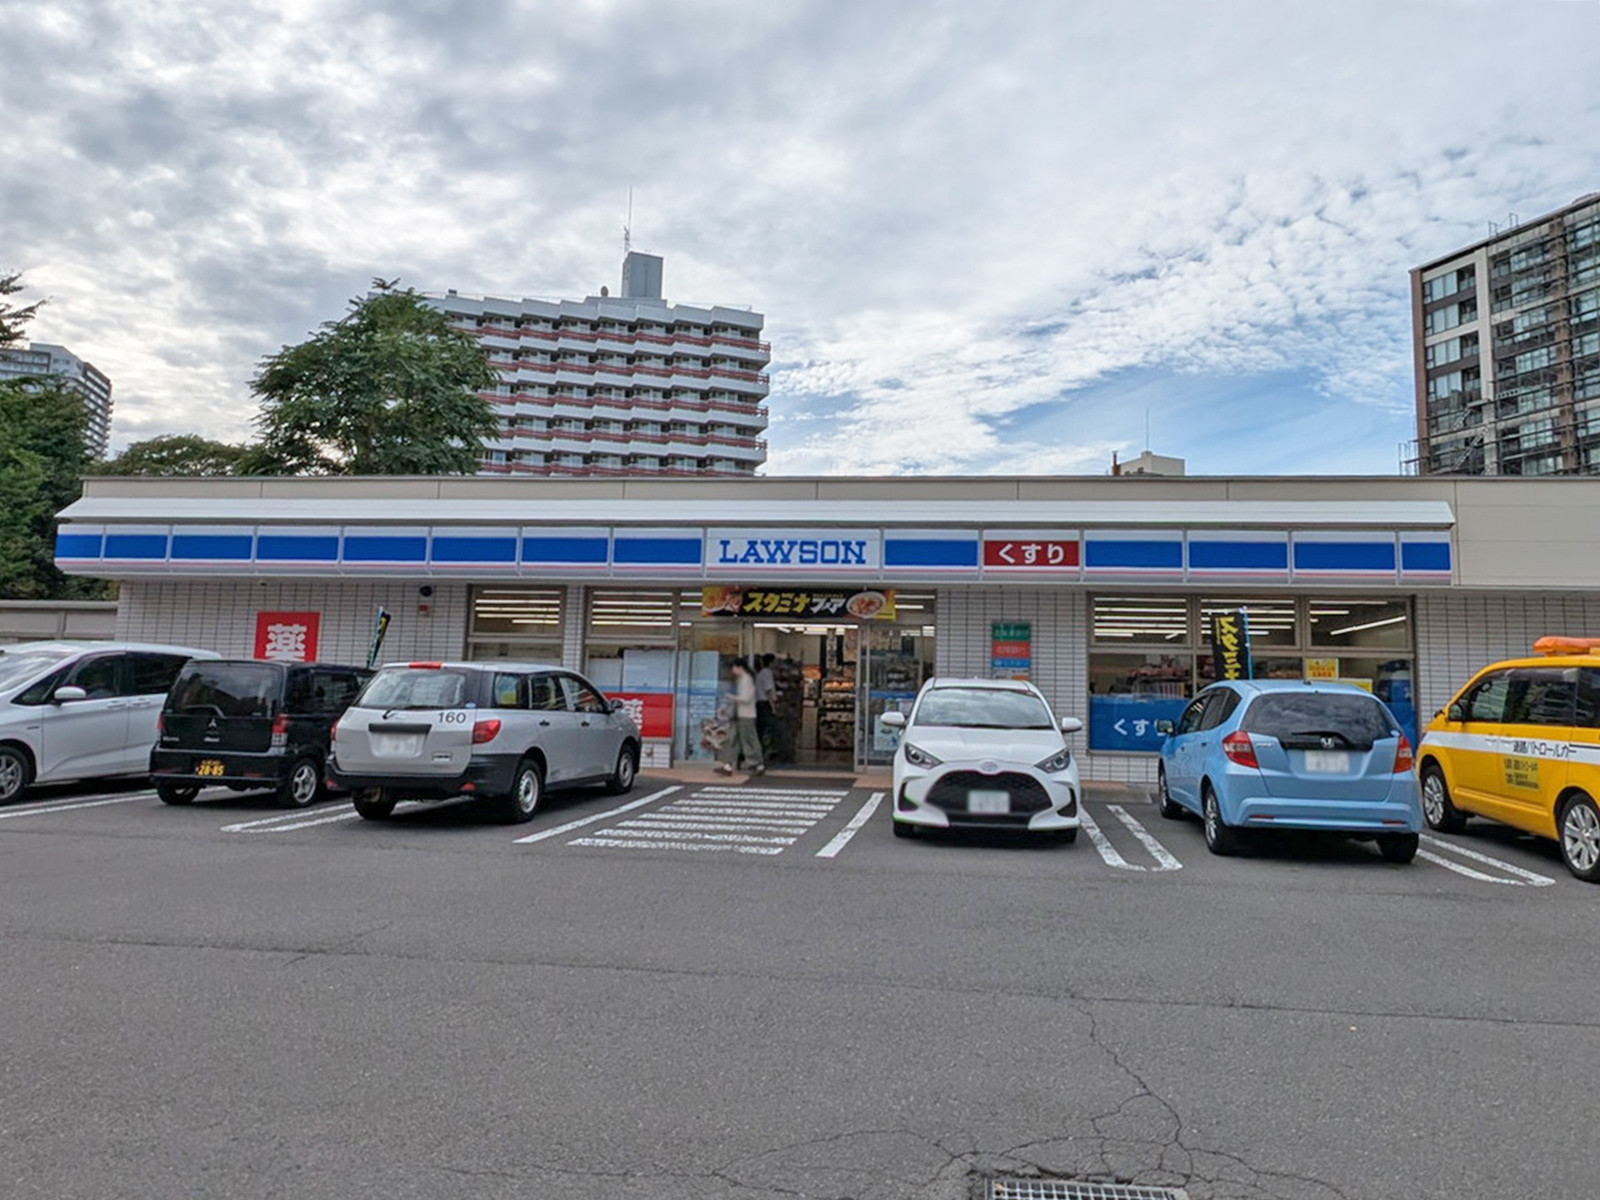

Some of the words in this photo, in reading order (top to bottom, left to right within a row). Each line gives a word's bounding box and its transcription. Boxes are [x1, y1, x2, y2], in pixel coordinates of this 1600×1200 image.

[719, 540, 867, 564] LAWSON
[998, 544, 1065, 564] くすり
[265, 623, 307, 661] 薬
[439, 711, 466, 724] 160
